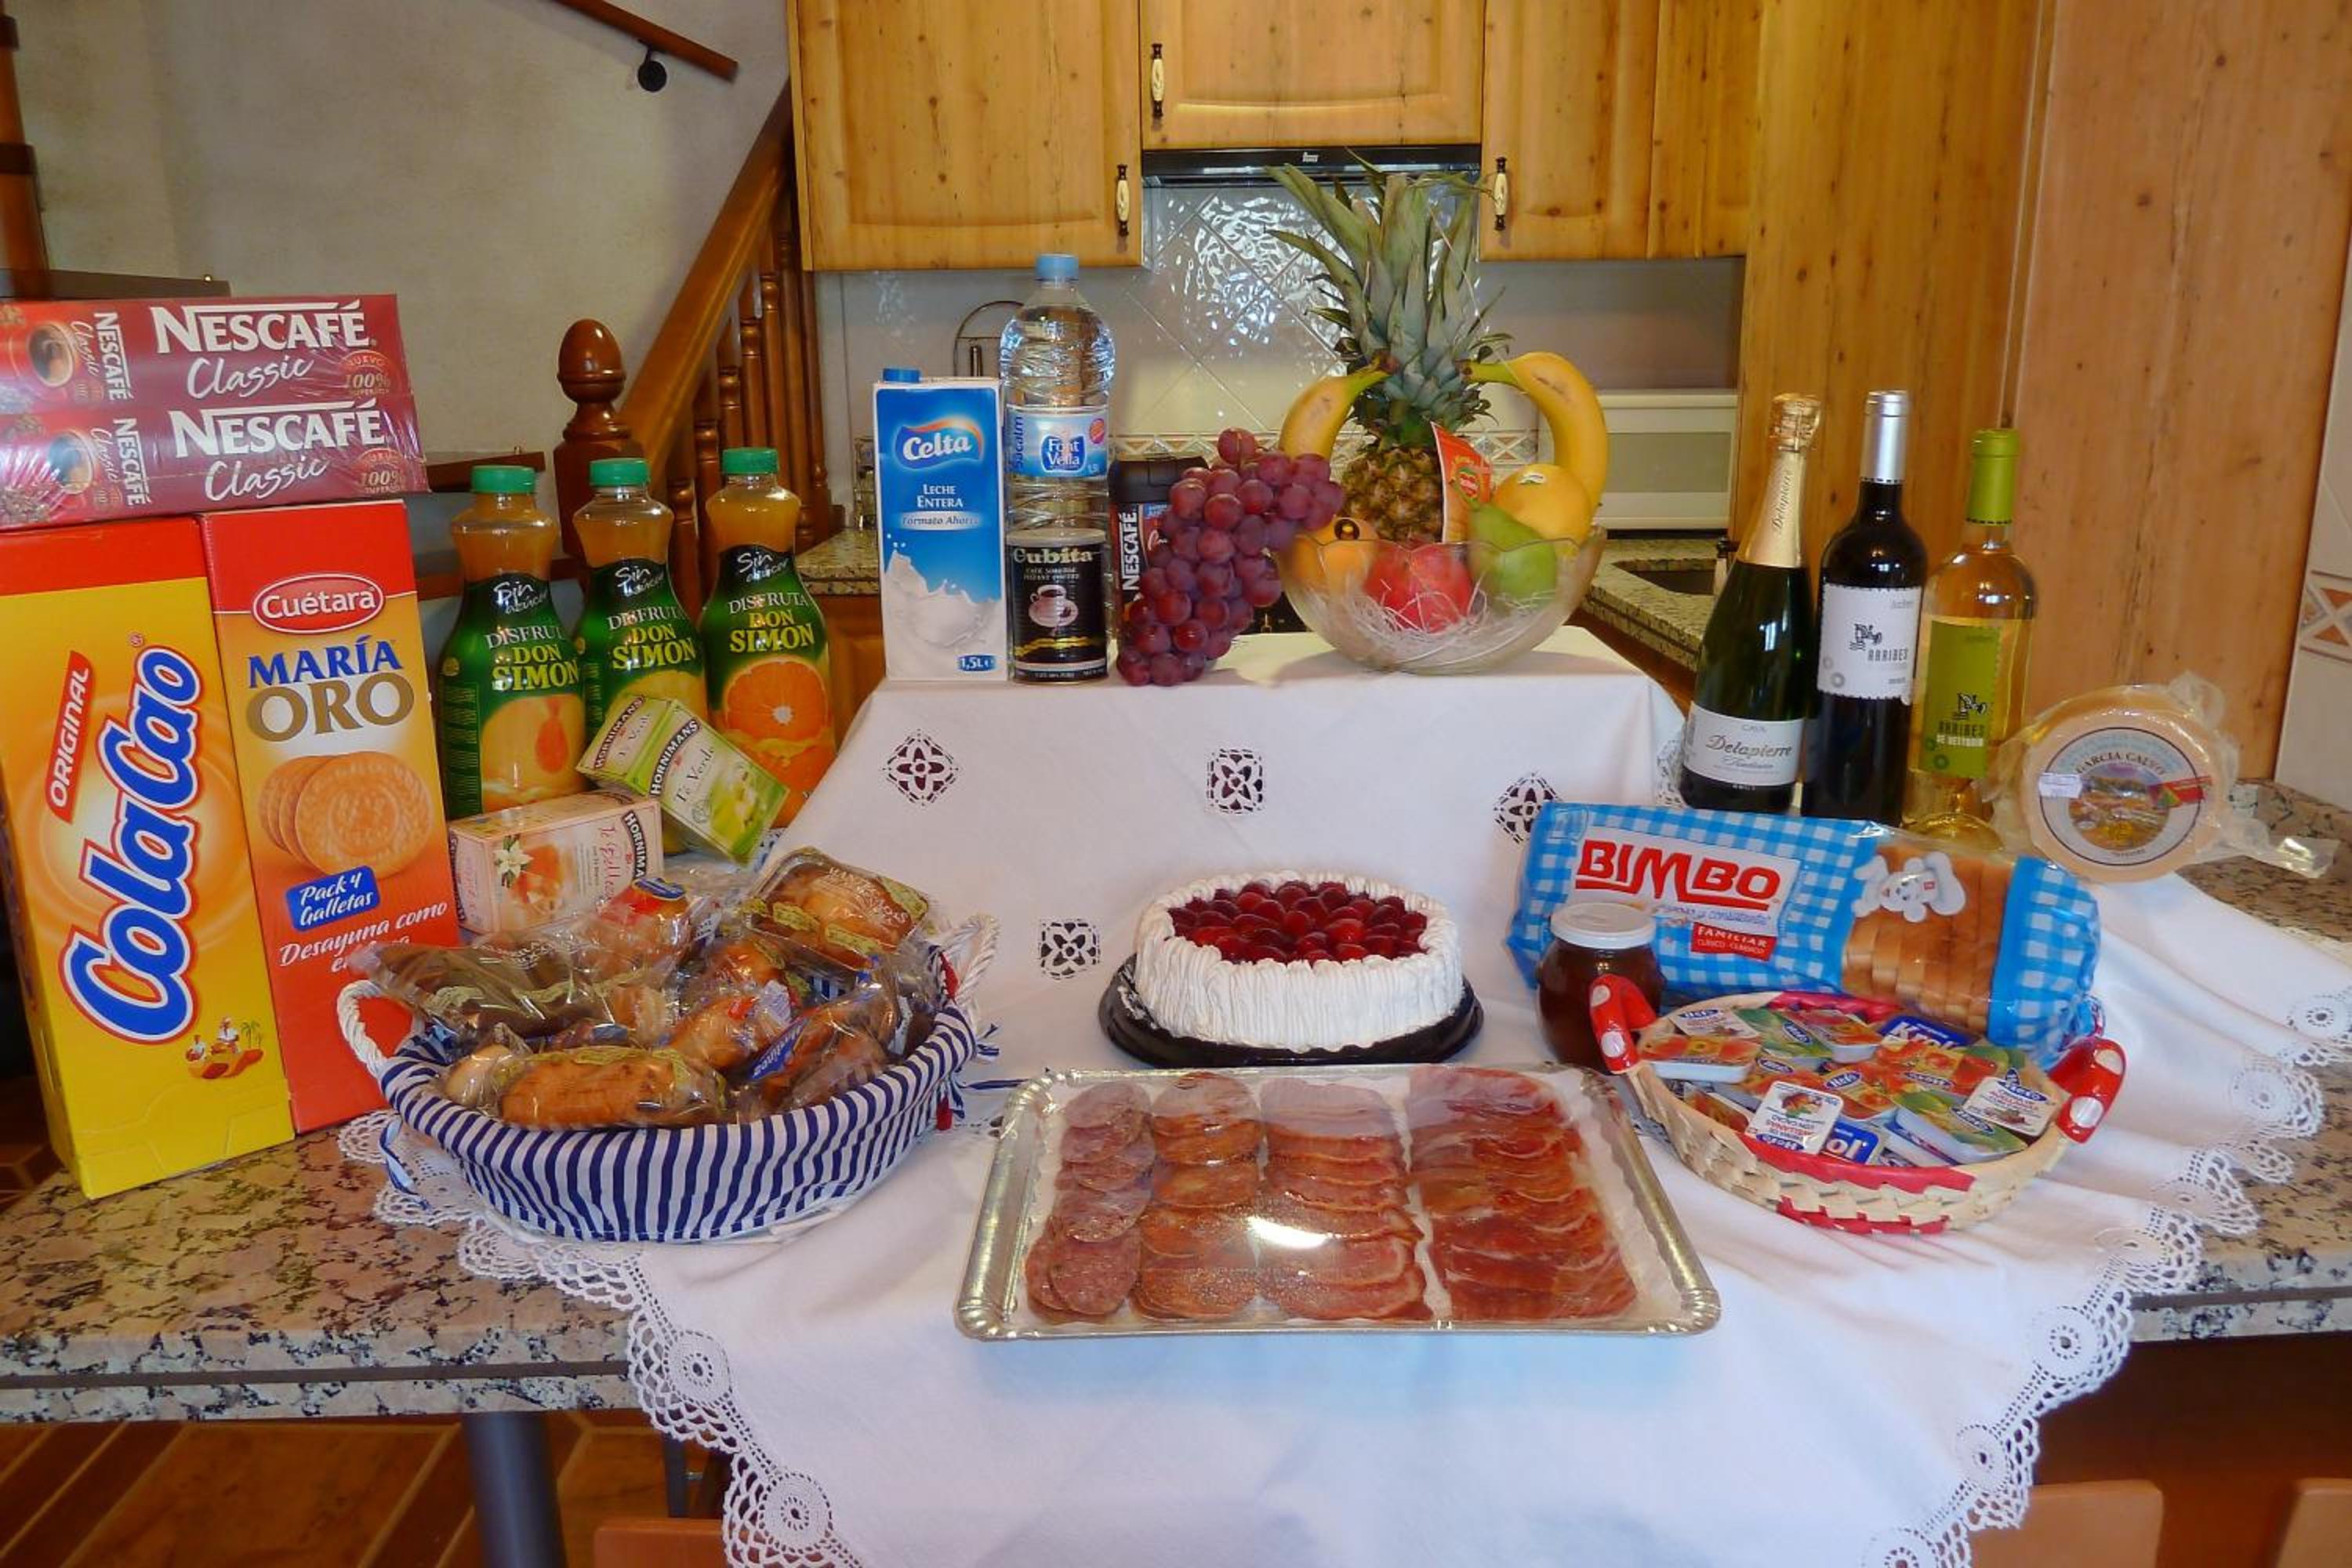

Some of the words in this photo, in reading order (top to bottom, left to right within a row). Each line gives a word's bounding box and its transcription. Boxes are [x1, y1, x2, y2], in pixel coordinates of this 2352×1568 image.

[71, 320, 101, 377] Classic
[151, 299, 369, 354] NESCAFÉ
[93, 312, 134, 401] NESCAFÉ
[187, 355, 314, 399] Classic
[168, 398, 385, 458] NESCAFÉ
[903, 432, 973, 461] Celta
[89, 427, 118, 483] Classic
[113, 418, 151, 506] NESCAFÉ
[205, 455, 328, 501] Classic
[916, 495, 964, 508] ENTERA
[923, 484, 956, 495] LECHE
[738, 550, 774, 575] Sin
[1013, 547, 1094, 564] Cubita
[1118, 511, 1140, 590] NESCAFÉ
[262, 586, 377, 619] Cuétara
[728, 592, 808, 614] DISFRUTA
[749, 610, 794, 628] DON
[512, 644, 562, 665] DON
[613, 637, 696, 670] SIMON
[631, 623, 677, 644] DON
[730, 623, 815, 652] SIMON
[248, 634, 403, 688] MARÍA
[246, 673, 414, 742] ORO
[52, 666, 91, 808] ORIGINAL
[594, 695, 644, 769] HORNIMANS
[650, 719, 700, 797] HORNIMANS
[625, 812, 646, 878] HORNIMA
[299, 876, 347, 906] Pack
[351, 872, 363, 887] 4
[1576, 840, 1780, 911] BIMBO
[300, 892, 373, 926] Galletas
[280, 920, 390, 967] Desayuna
[395, 902, 448, 929] como
